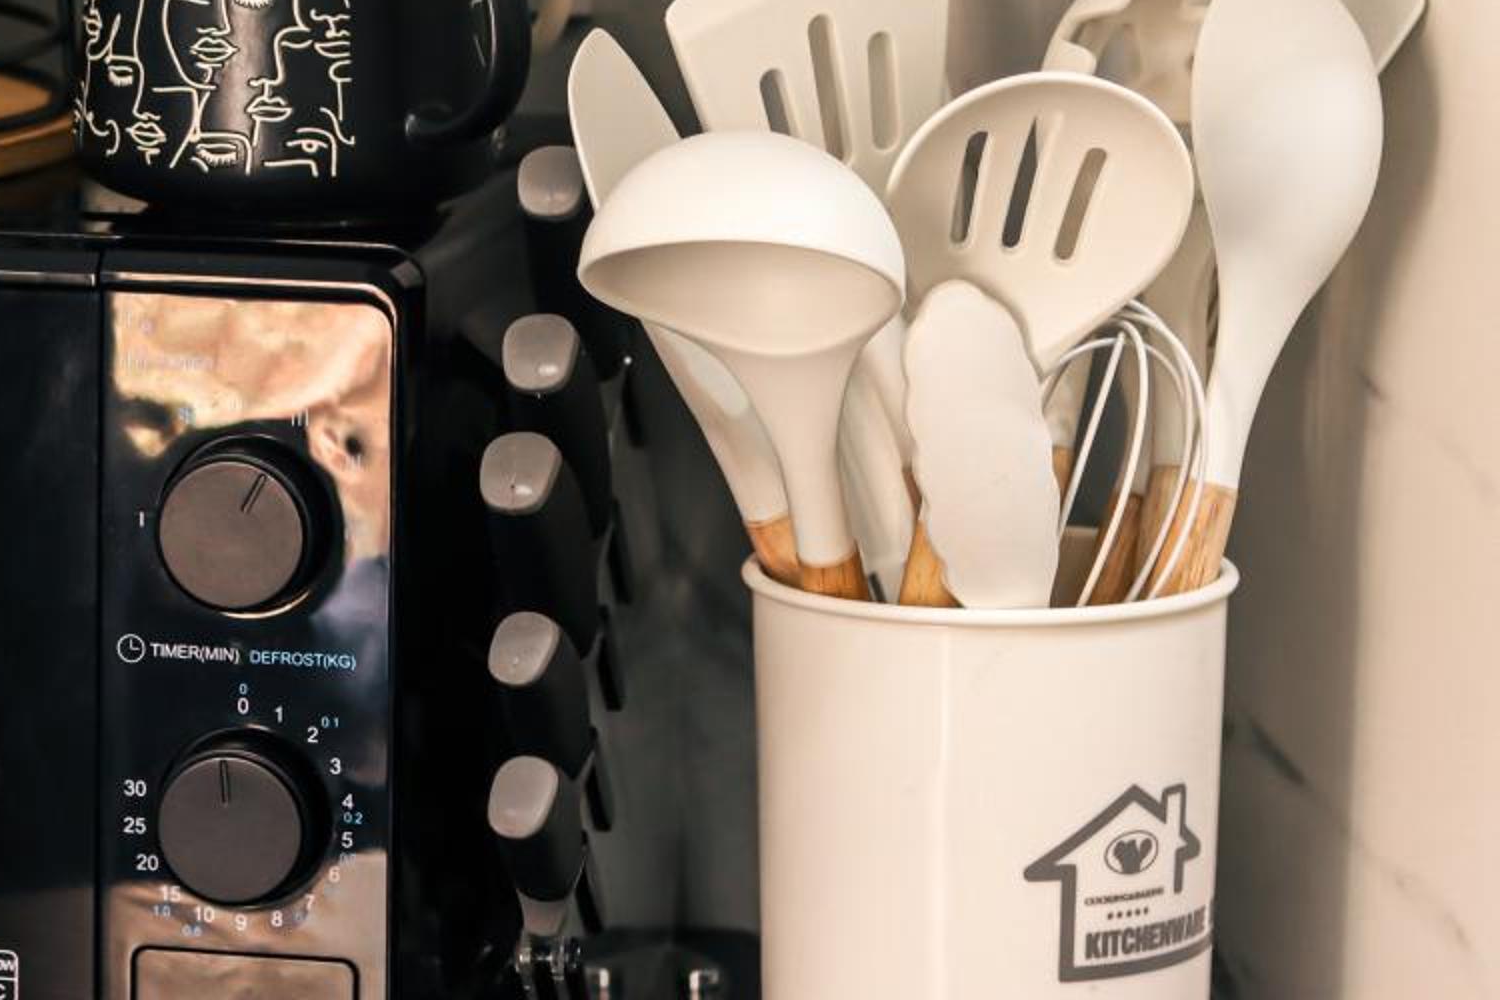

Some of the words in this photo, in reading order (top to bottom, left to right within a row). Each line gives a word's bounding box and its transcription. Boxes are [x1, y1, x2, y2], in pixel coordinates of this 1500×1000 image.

[149, 642, 241, 663] TIMER(MIN)
[250, 650, 357, 670] DEFROST(KG)
[237, 697, 249, 714] 0
[275, 705, 284, 723] 1
[307, 726, 319, 743] 2
[329, 757, 342, 775] 3
[124, 779, 147, 797] 30
[341, 793, 354, 810] 4
[123, 817, 147, 835] 25
[341, 831, 354, 848] 5
[136, 855, 159, 872] 20
[328, 866, 341, 883] 6
[160, 885, 181, 902] 15
[304, 894, 316, 911] 7
[194, 906, 215, 923] 10
[234, 913, 248, 931] 9
[270, 910, 283, 927] 8
